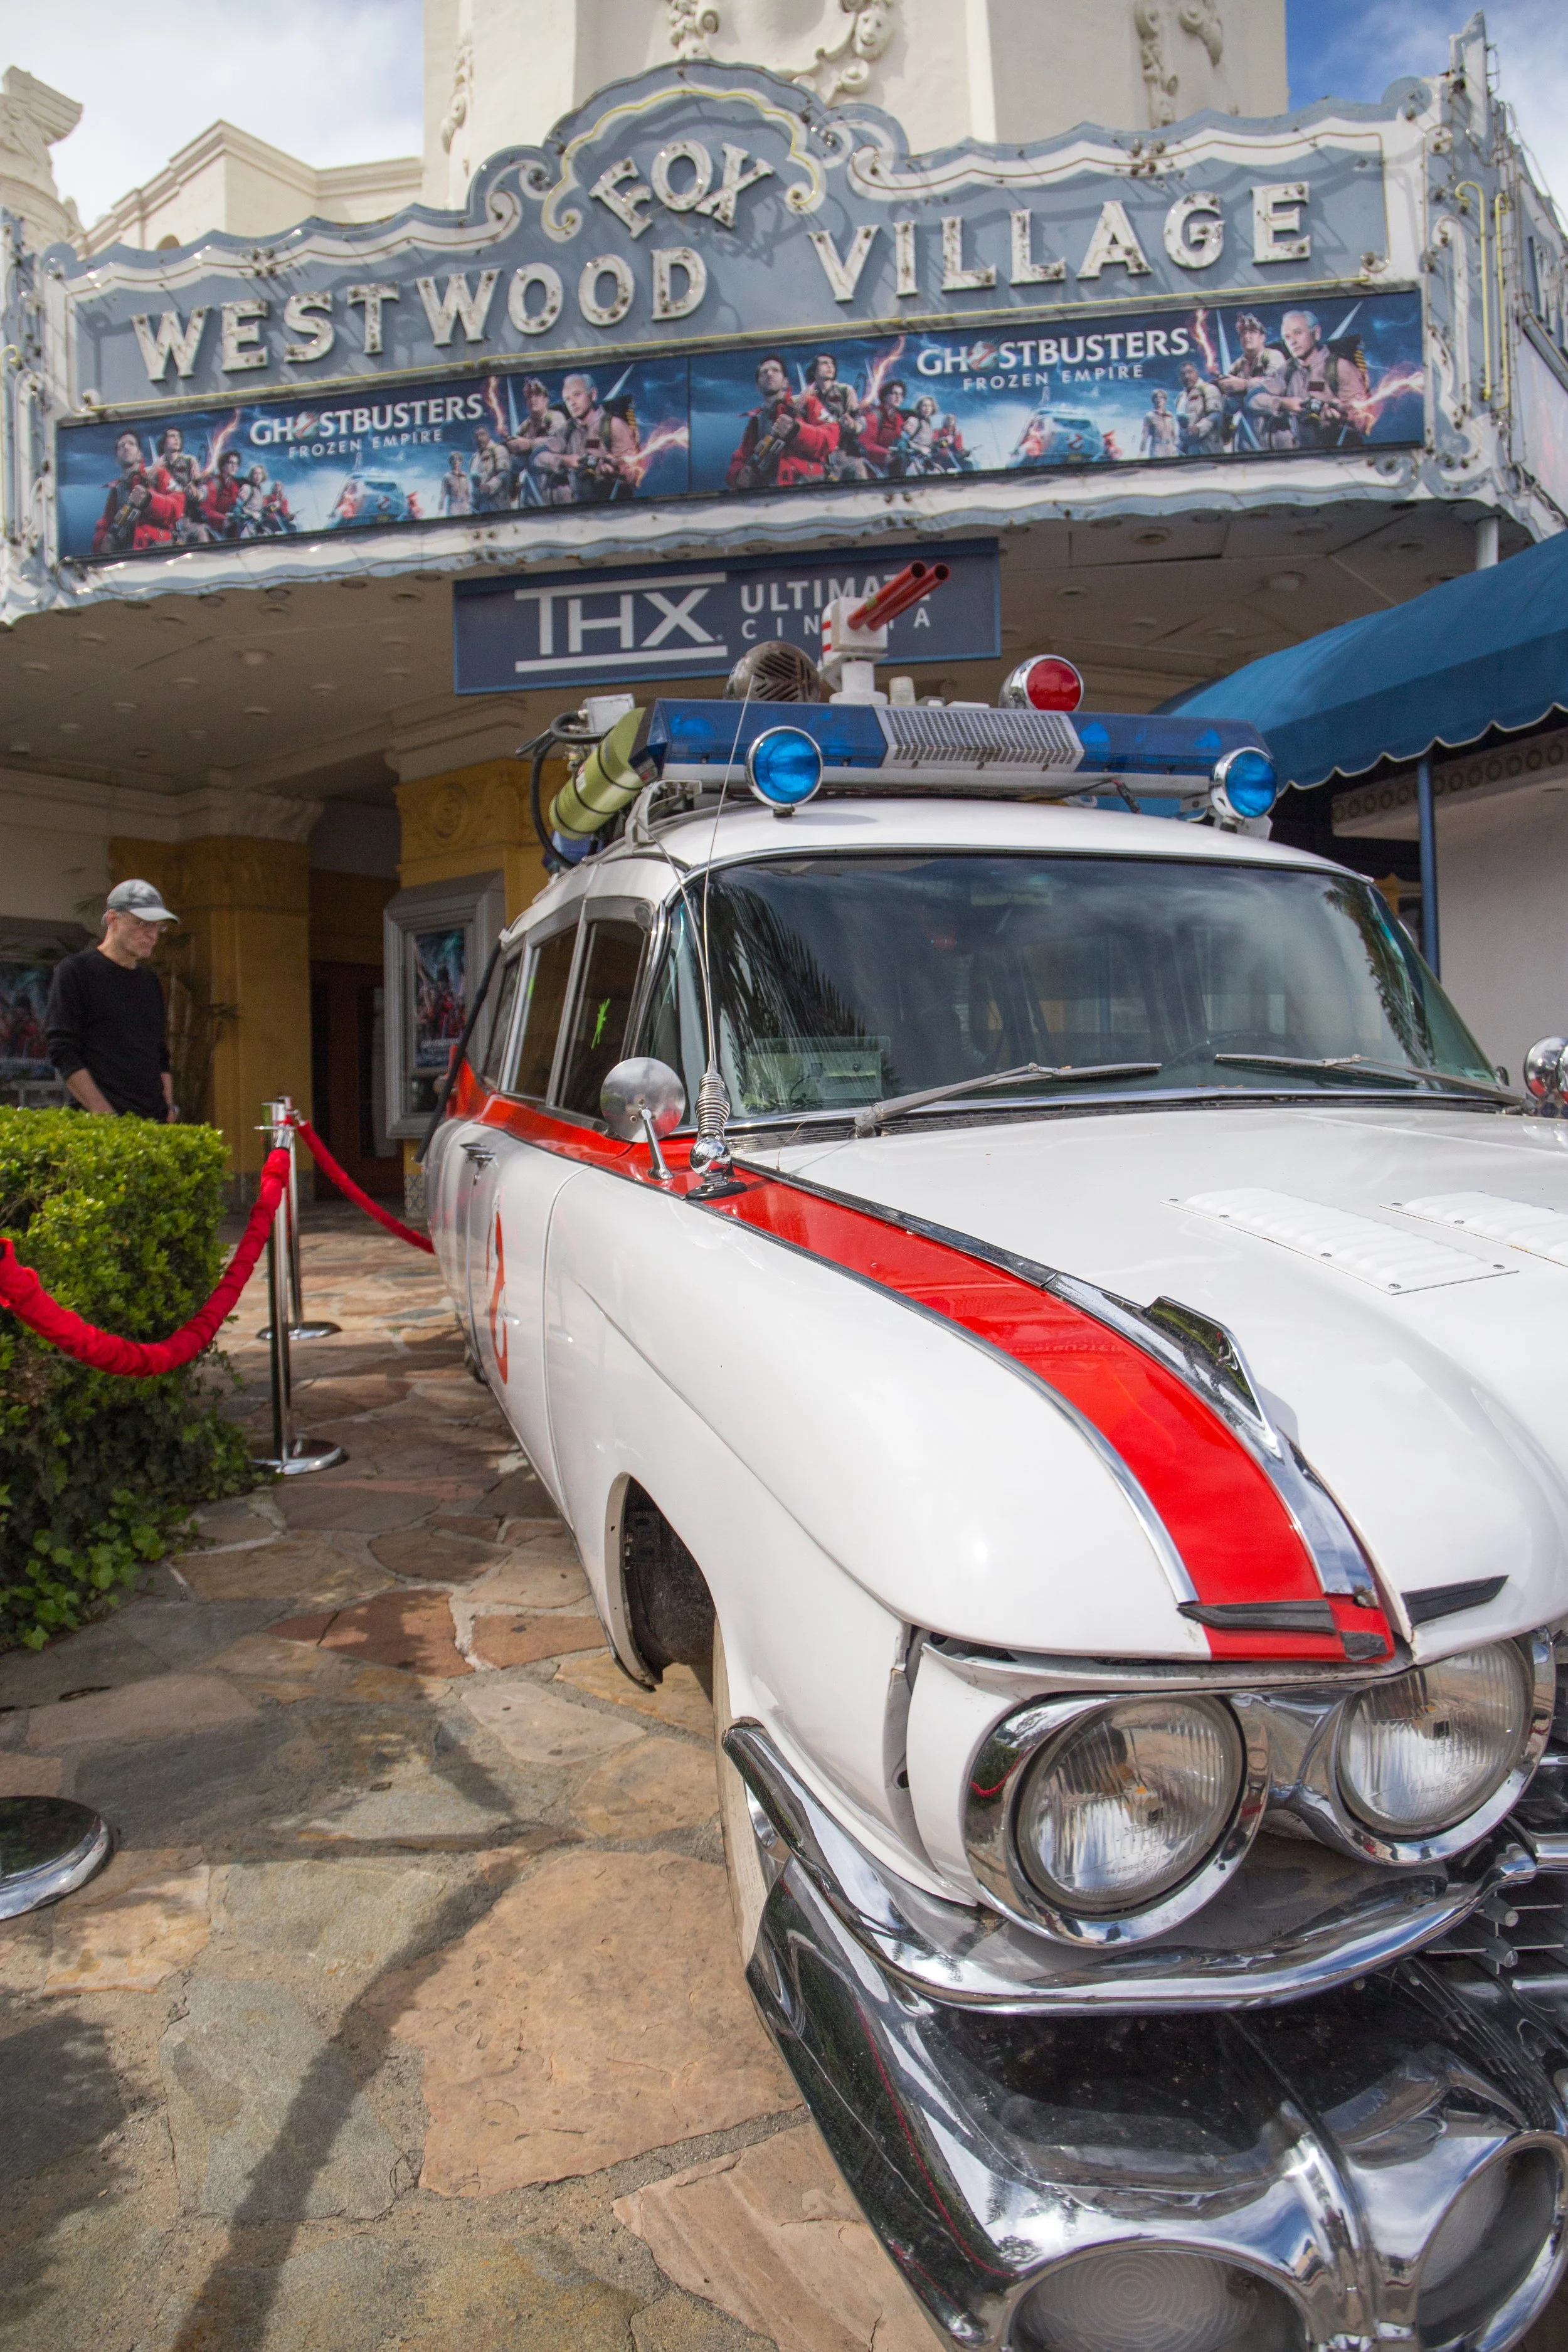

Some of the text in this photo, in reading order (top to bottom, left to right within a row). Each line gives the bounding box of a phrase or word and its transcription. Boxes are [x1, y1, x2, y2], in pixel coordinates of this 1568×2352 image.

[589, 140, 774, 240] FOX
[130, 181, 1311, 381] WESTWOOD VILLAGE
[963, 364, 1143, 391] FROZEN EMPIRE
[289, 429, 443, 459] FROZEN EMPIRE
[514, 571, 728, 656] THX
[741, 607, 931, 640] CINA
